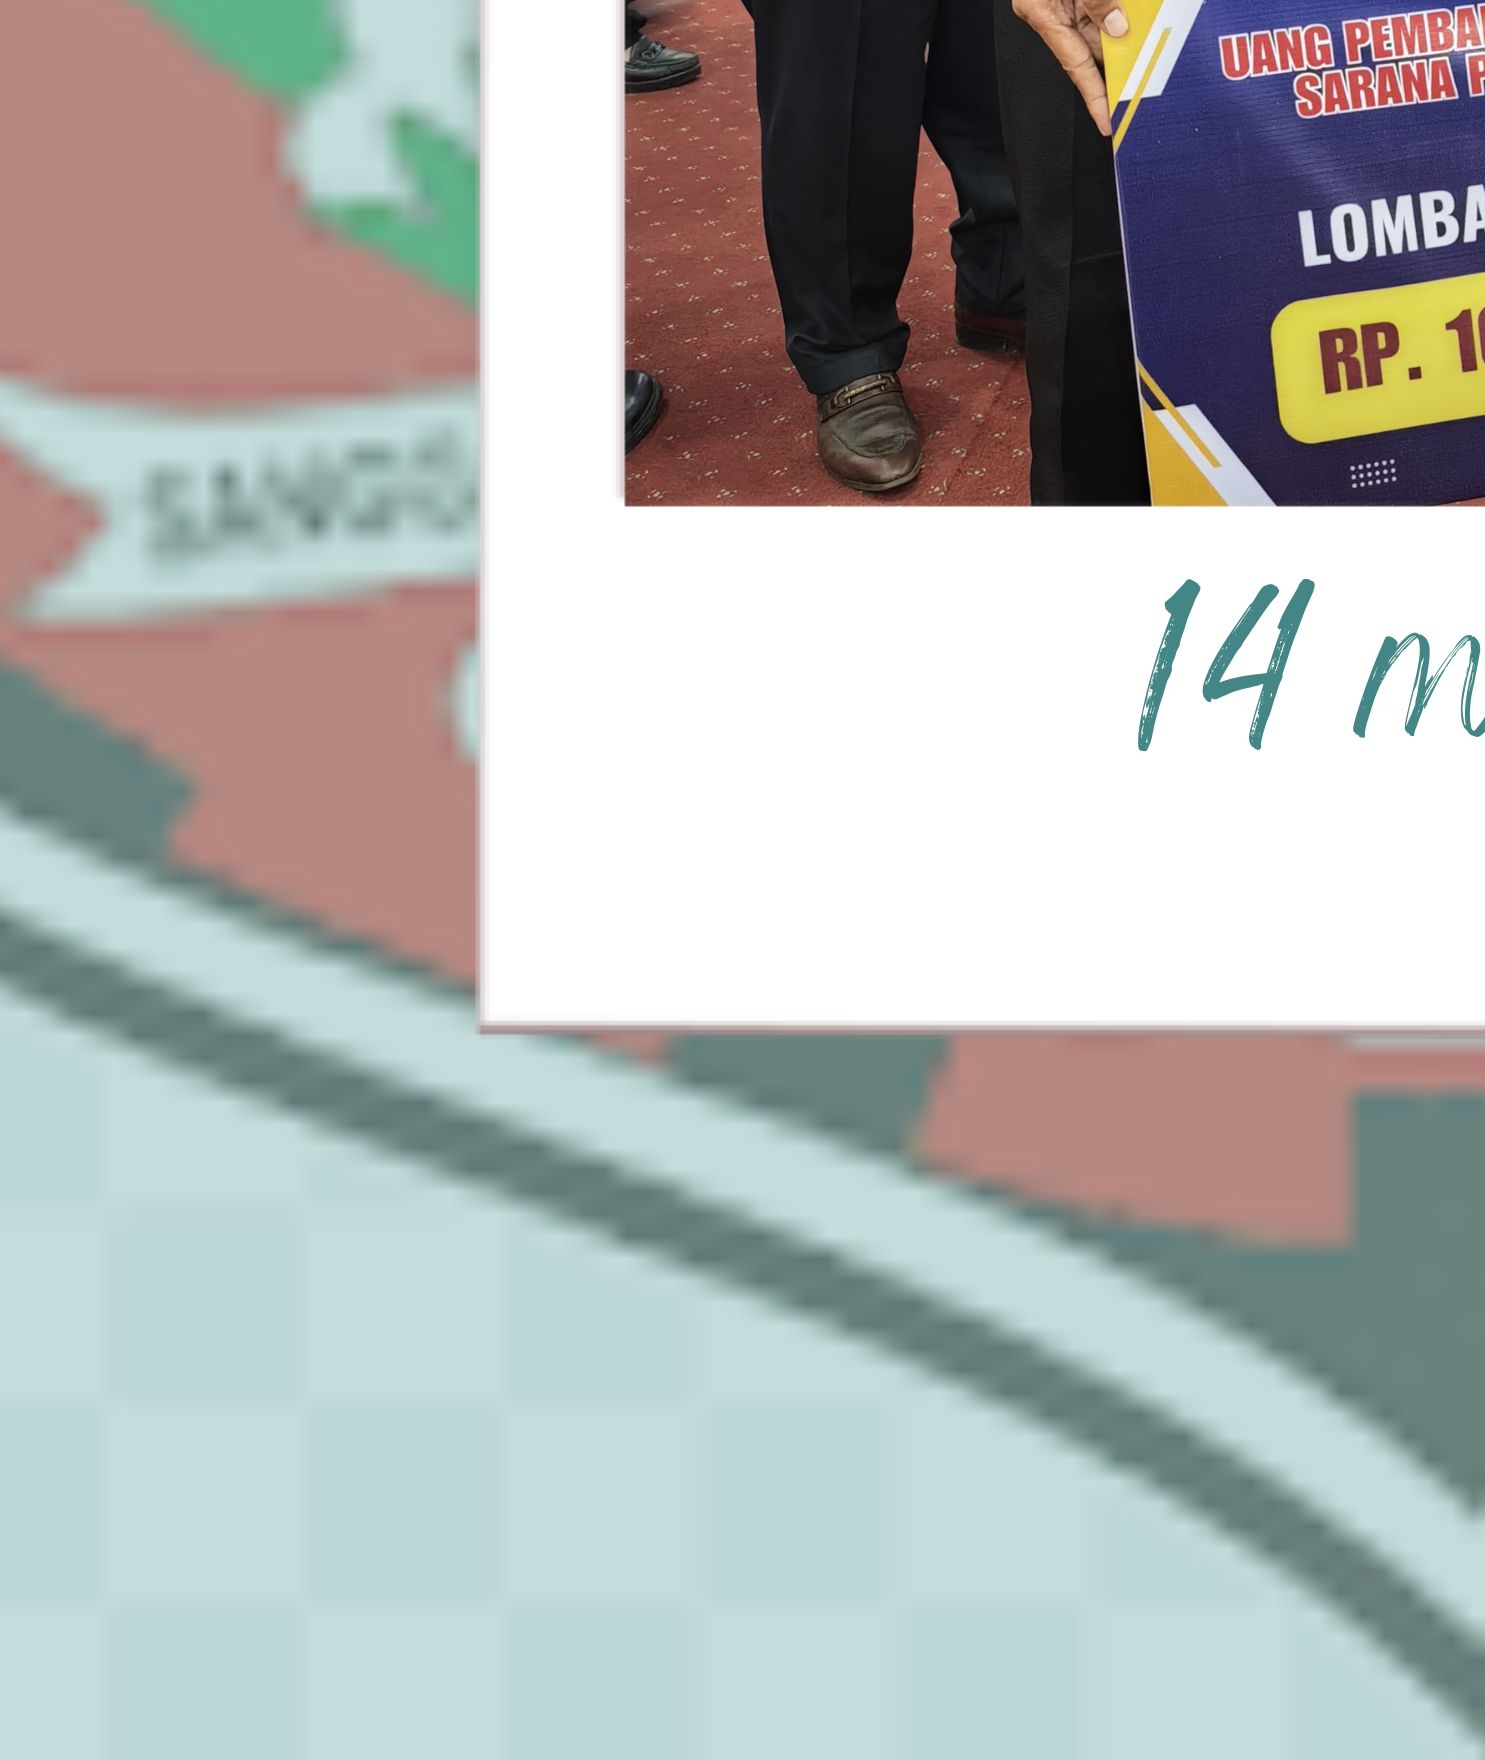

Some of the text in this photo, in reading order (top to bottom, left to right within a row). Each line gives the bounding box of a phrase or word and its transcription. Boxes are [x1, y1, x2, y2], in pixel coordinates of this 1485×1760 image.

[1218, 22, 1332, 81] UANG
[1293, 58, 1458, 120] SARANA
[1318, 321, 1422, 395] RP.
